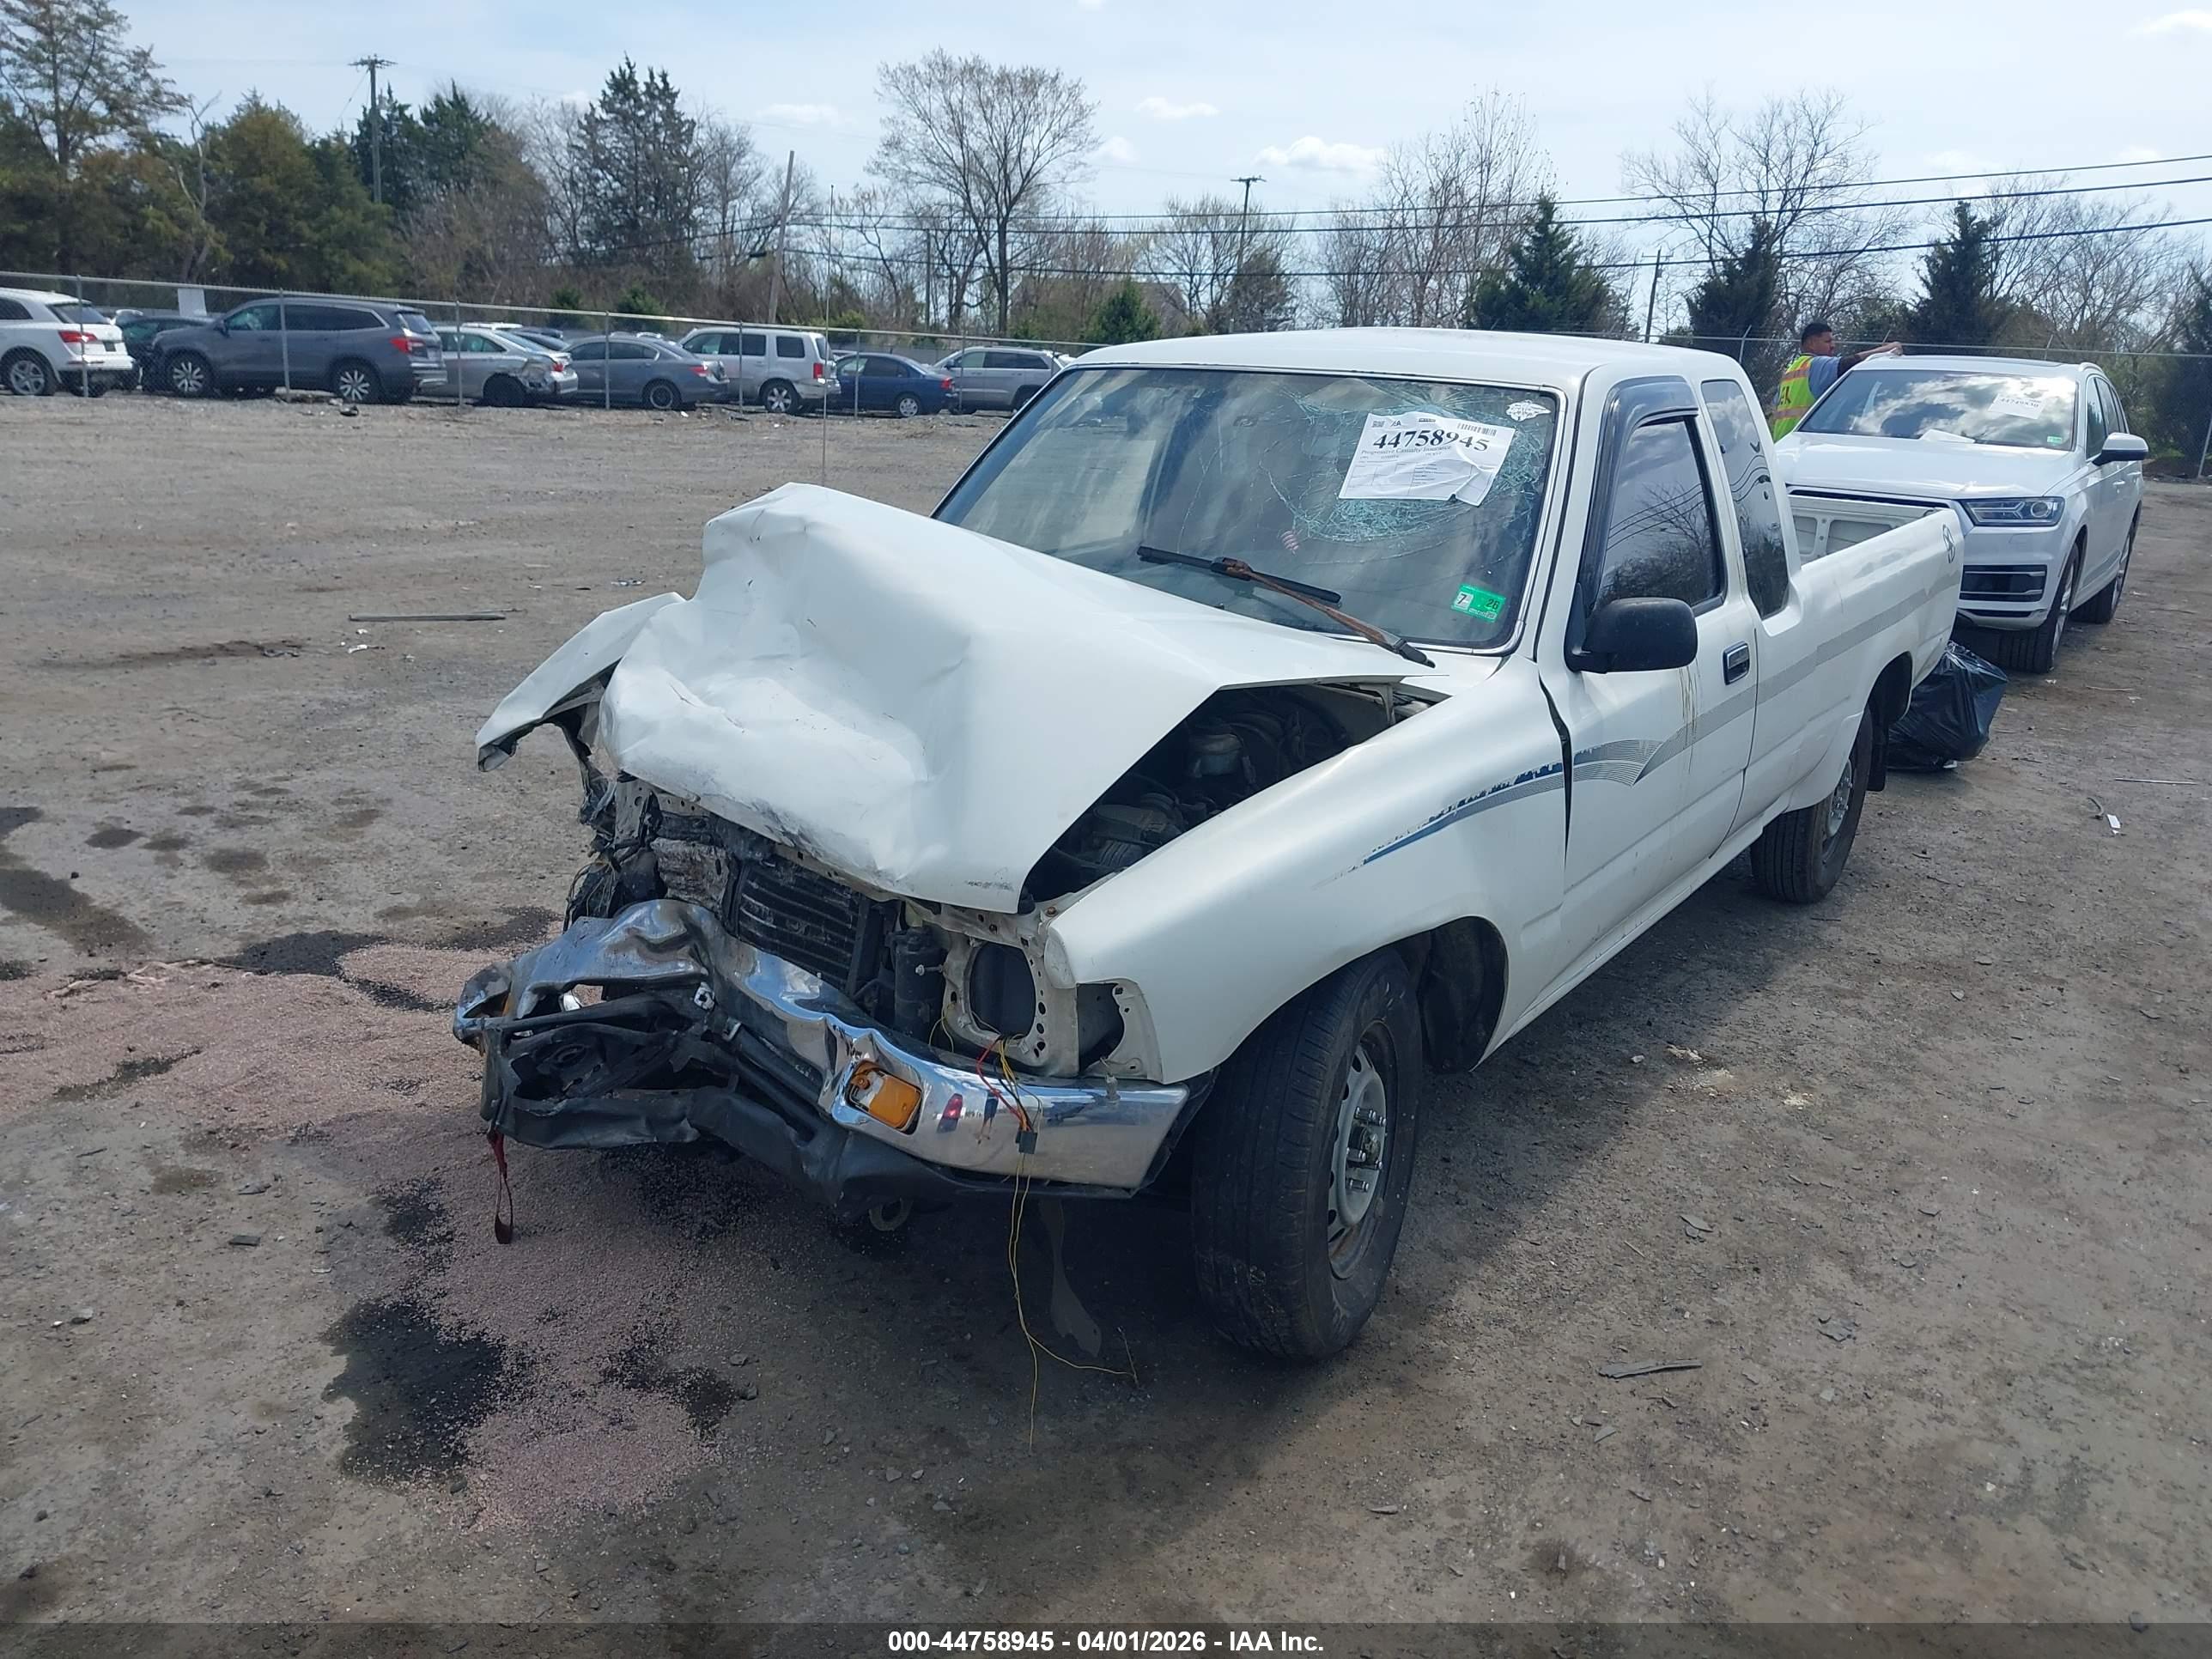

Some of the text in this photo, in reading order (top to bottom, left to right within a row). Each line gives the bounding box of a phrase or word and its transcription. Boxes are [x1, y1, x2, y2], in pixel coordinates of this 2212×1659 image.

[1373, 429, 1491, 452] 44758945
[1457, 592, 1468, 605] 7
[1486, 599, 1499, 610] 26
